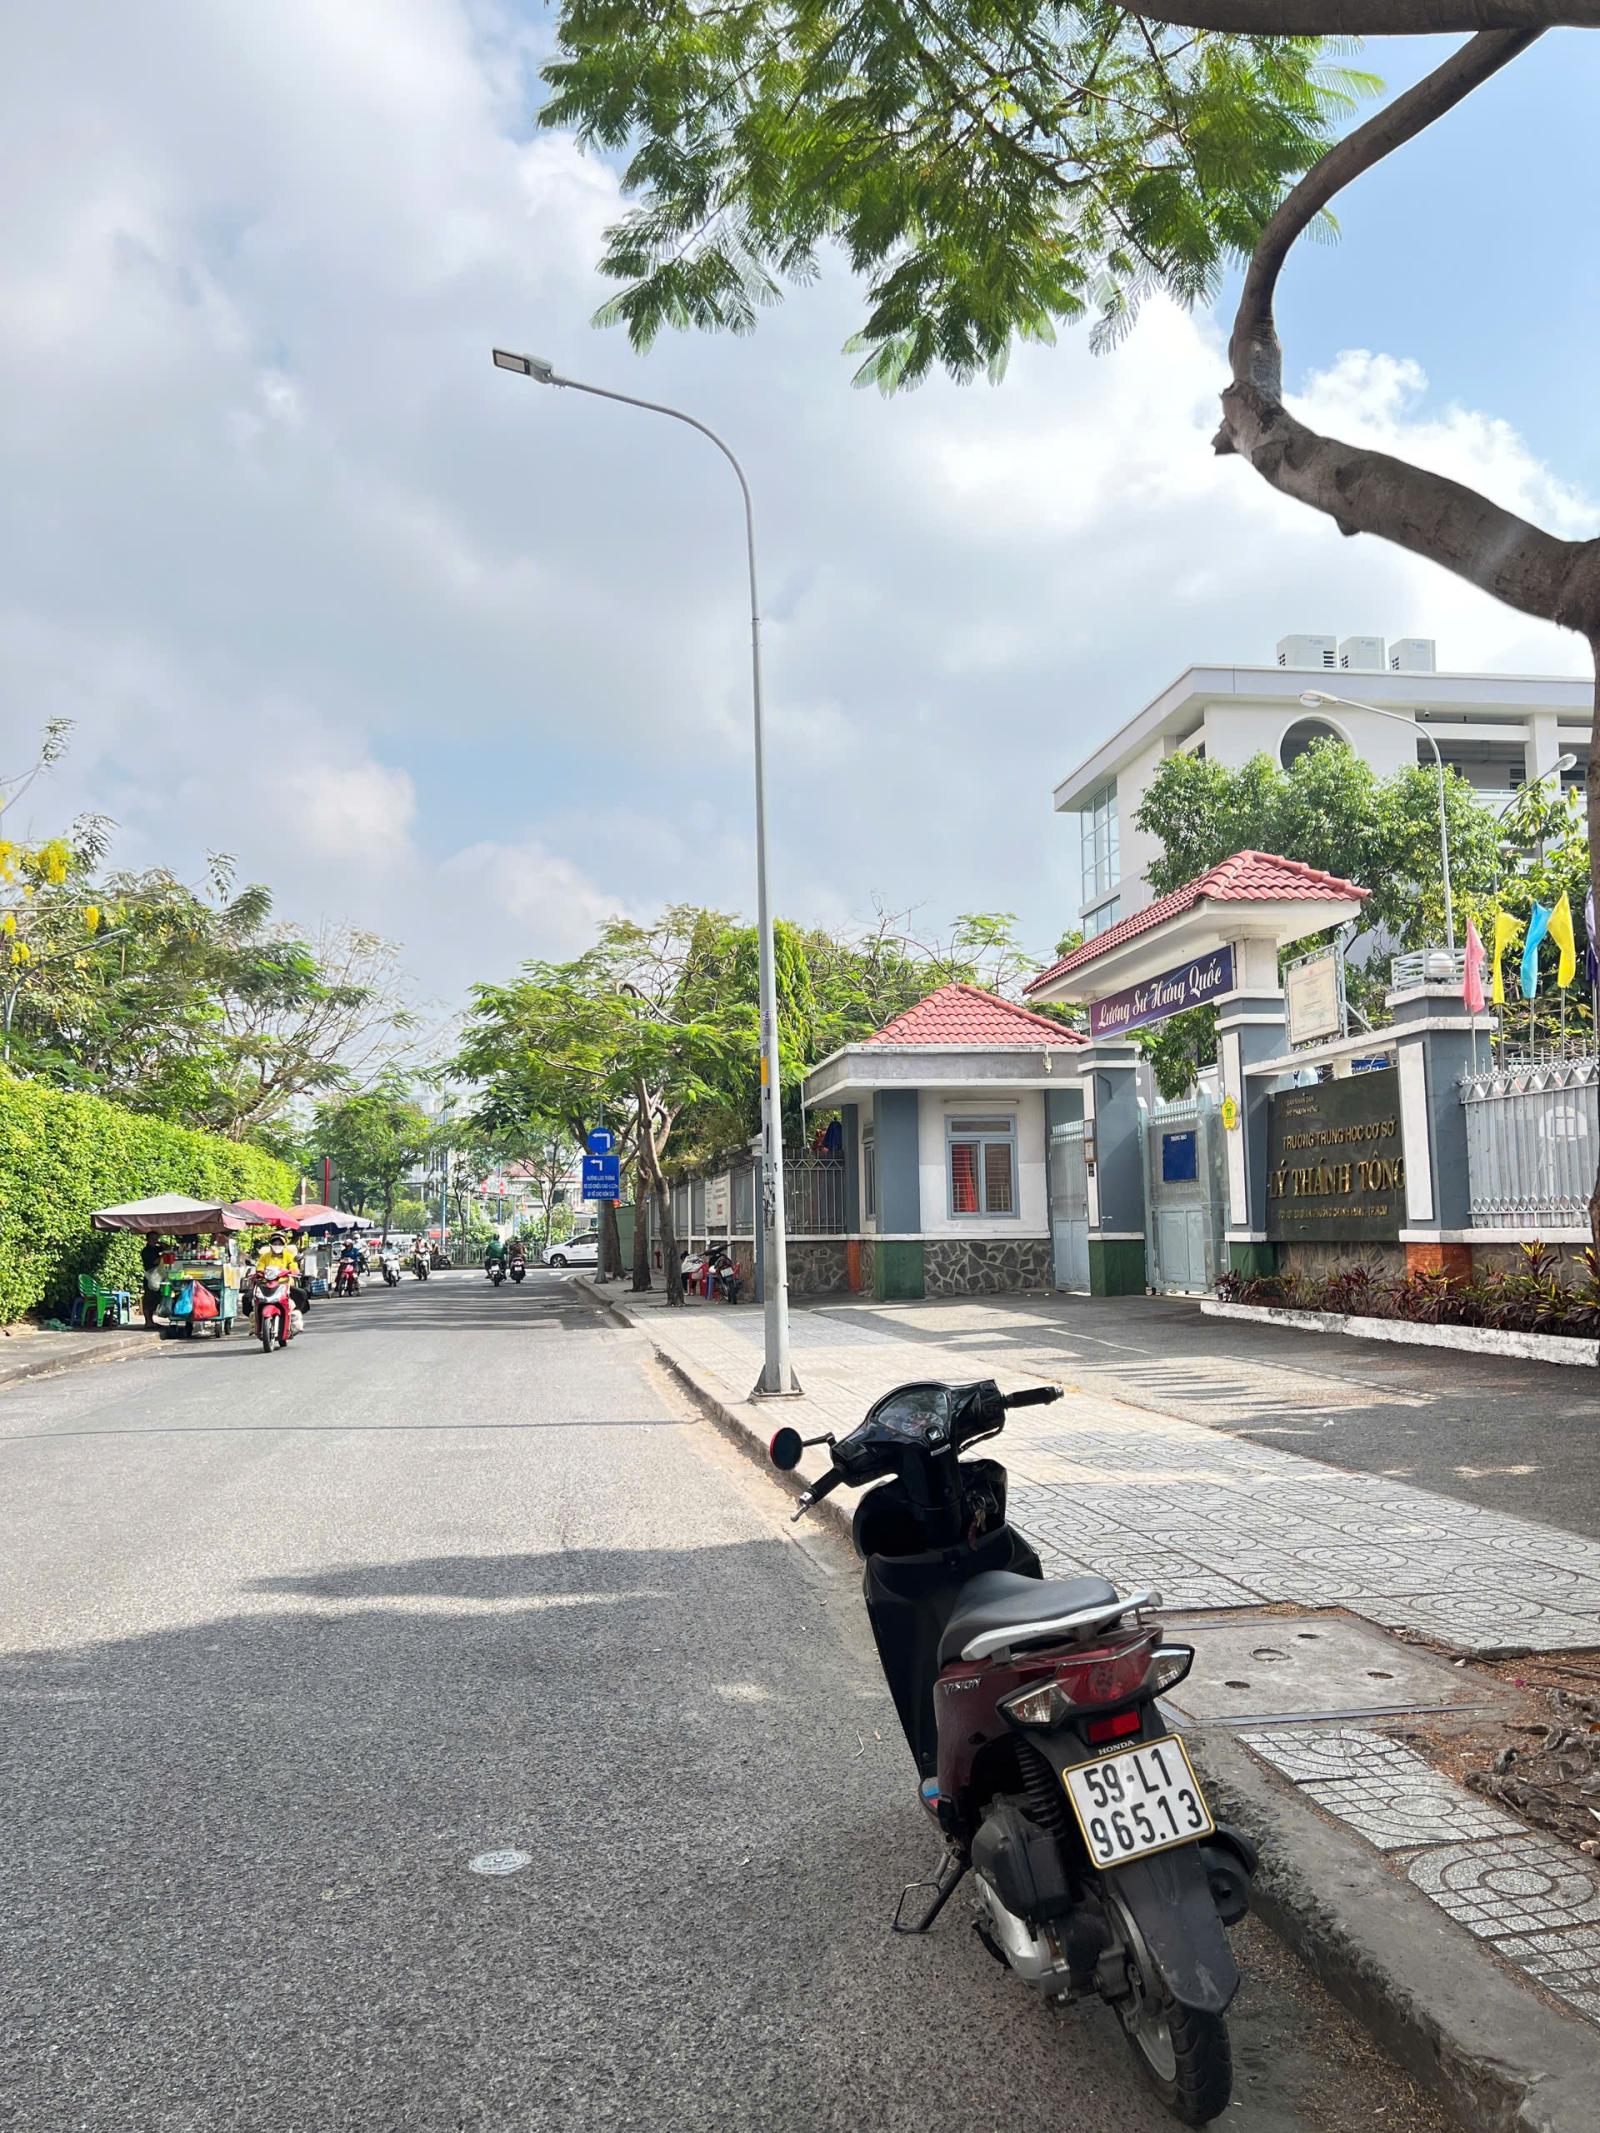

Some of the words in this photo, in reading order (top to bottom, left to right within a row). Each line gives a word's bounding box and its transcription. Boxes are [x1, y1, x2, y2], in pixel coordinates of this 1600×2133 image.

[1098, 1003, 1130, 1029] Lương
[1133, 990, 1148, 1015] Sư
[1188, 958, 1222, 998] Quốc
[1316, 1127, 1344, 1146] TRUNG
[1269, 1159, 1287, 1198] LÝ
[1292, 1157, 1352, 1196] THÁNH
[1358, 1150, 1406, 1192] TÔNG
[943, 1677, 982, 1696] VISION
[1098, 1739, 1135, 1755] HONDA
[1083, 1747, 1172, 1808] 59-L1
[1090, 1788, 1203, 1858] 965.13
